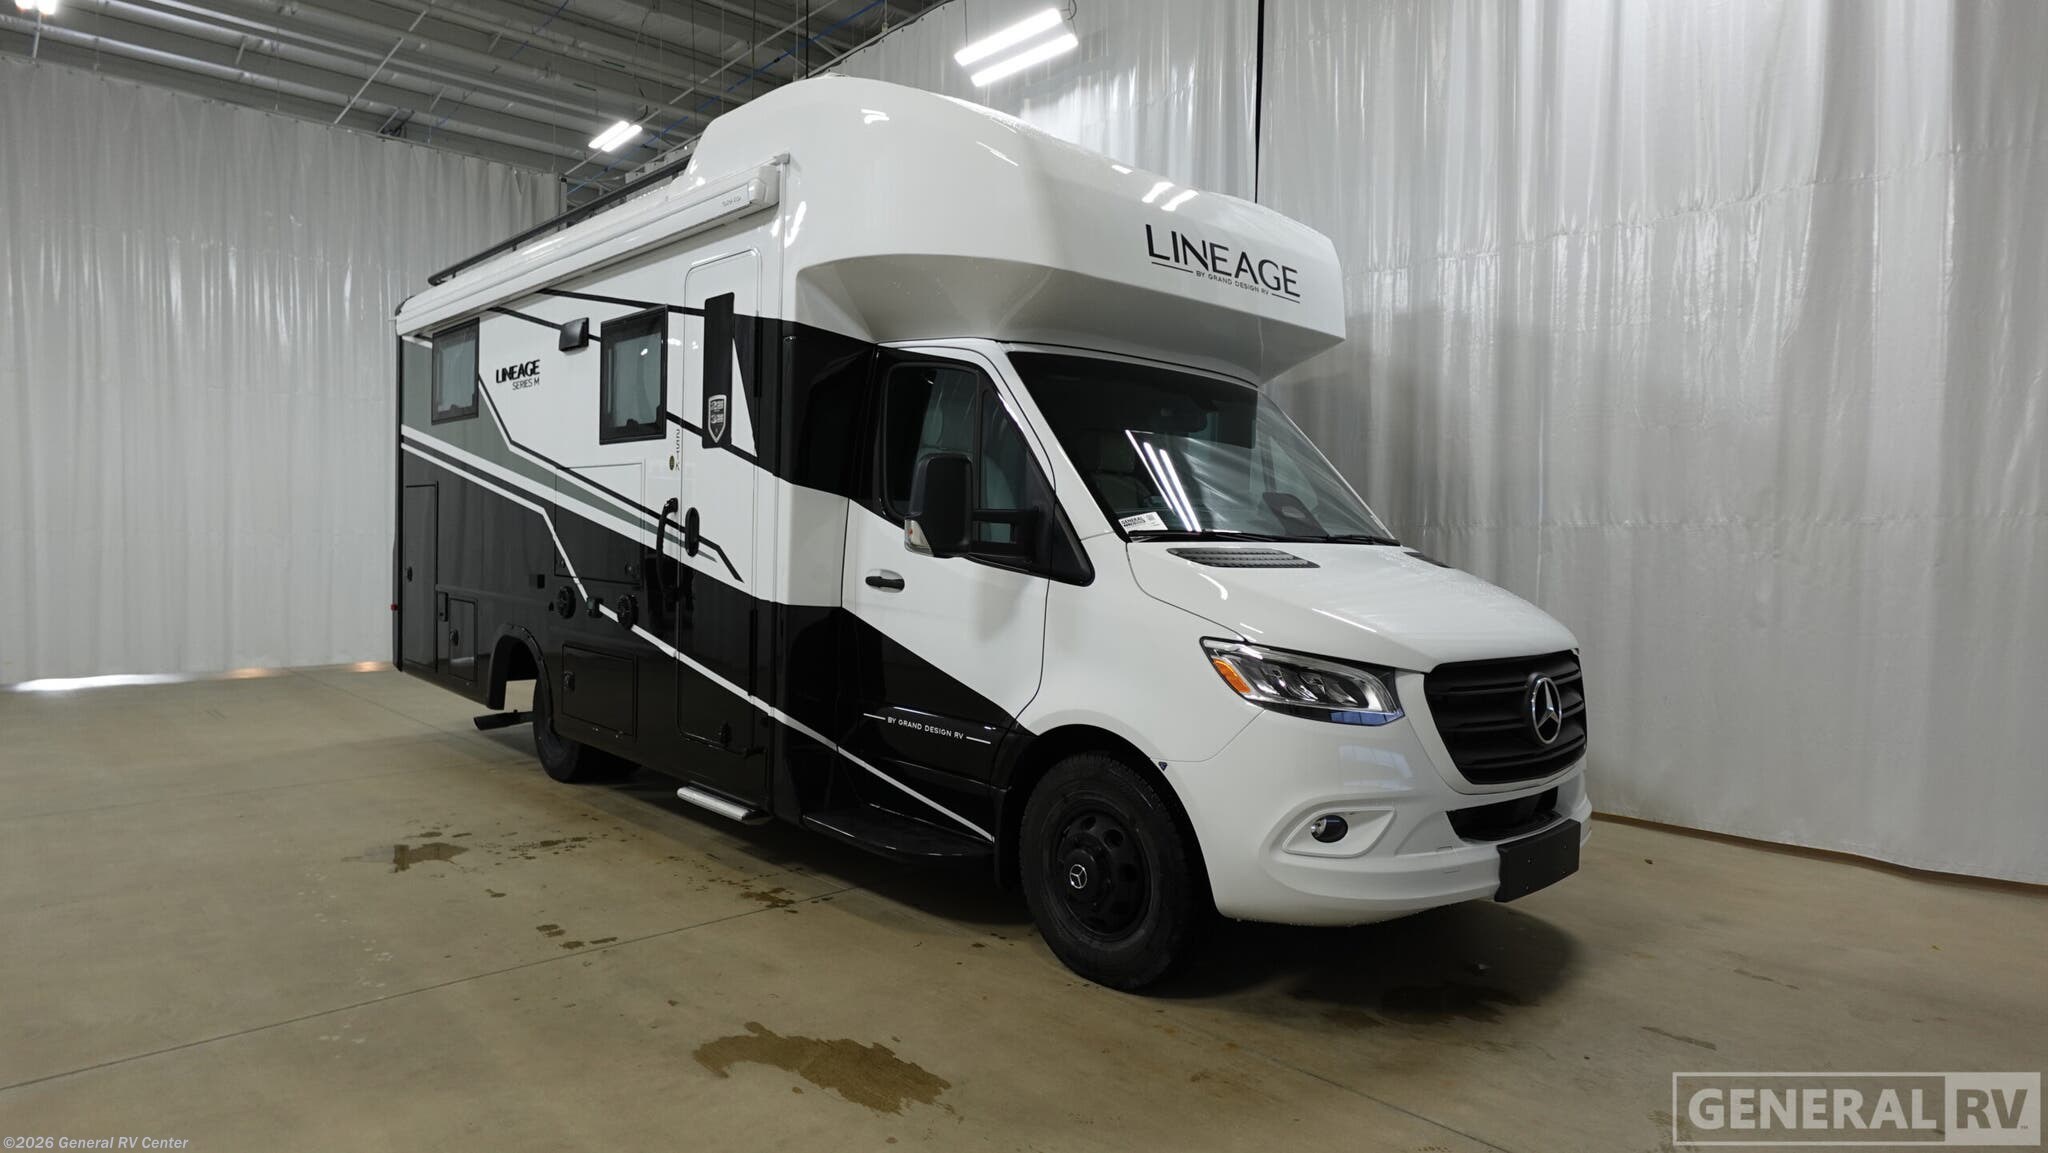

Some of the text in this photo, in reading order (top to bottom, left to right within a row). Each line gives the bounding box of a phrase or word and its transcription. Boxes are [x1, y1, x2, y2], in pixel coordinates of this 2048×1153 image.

[1145, 224, 1301, 297] LINEAGE
[1196, 270, 1269, 296] BY GRAND DESIGN RV
[495, 359, 541, 384] LINEAGE
[512, 376, 540, 391] SERIES M
[887, 716, 964, 740] BY GRAND DESIGN RV
